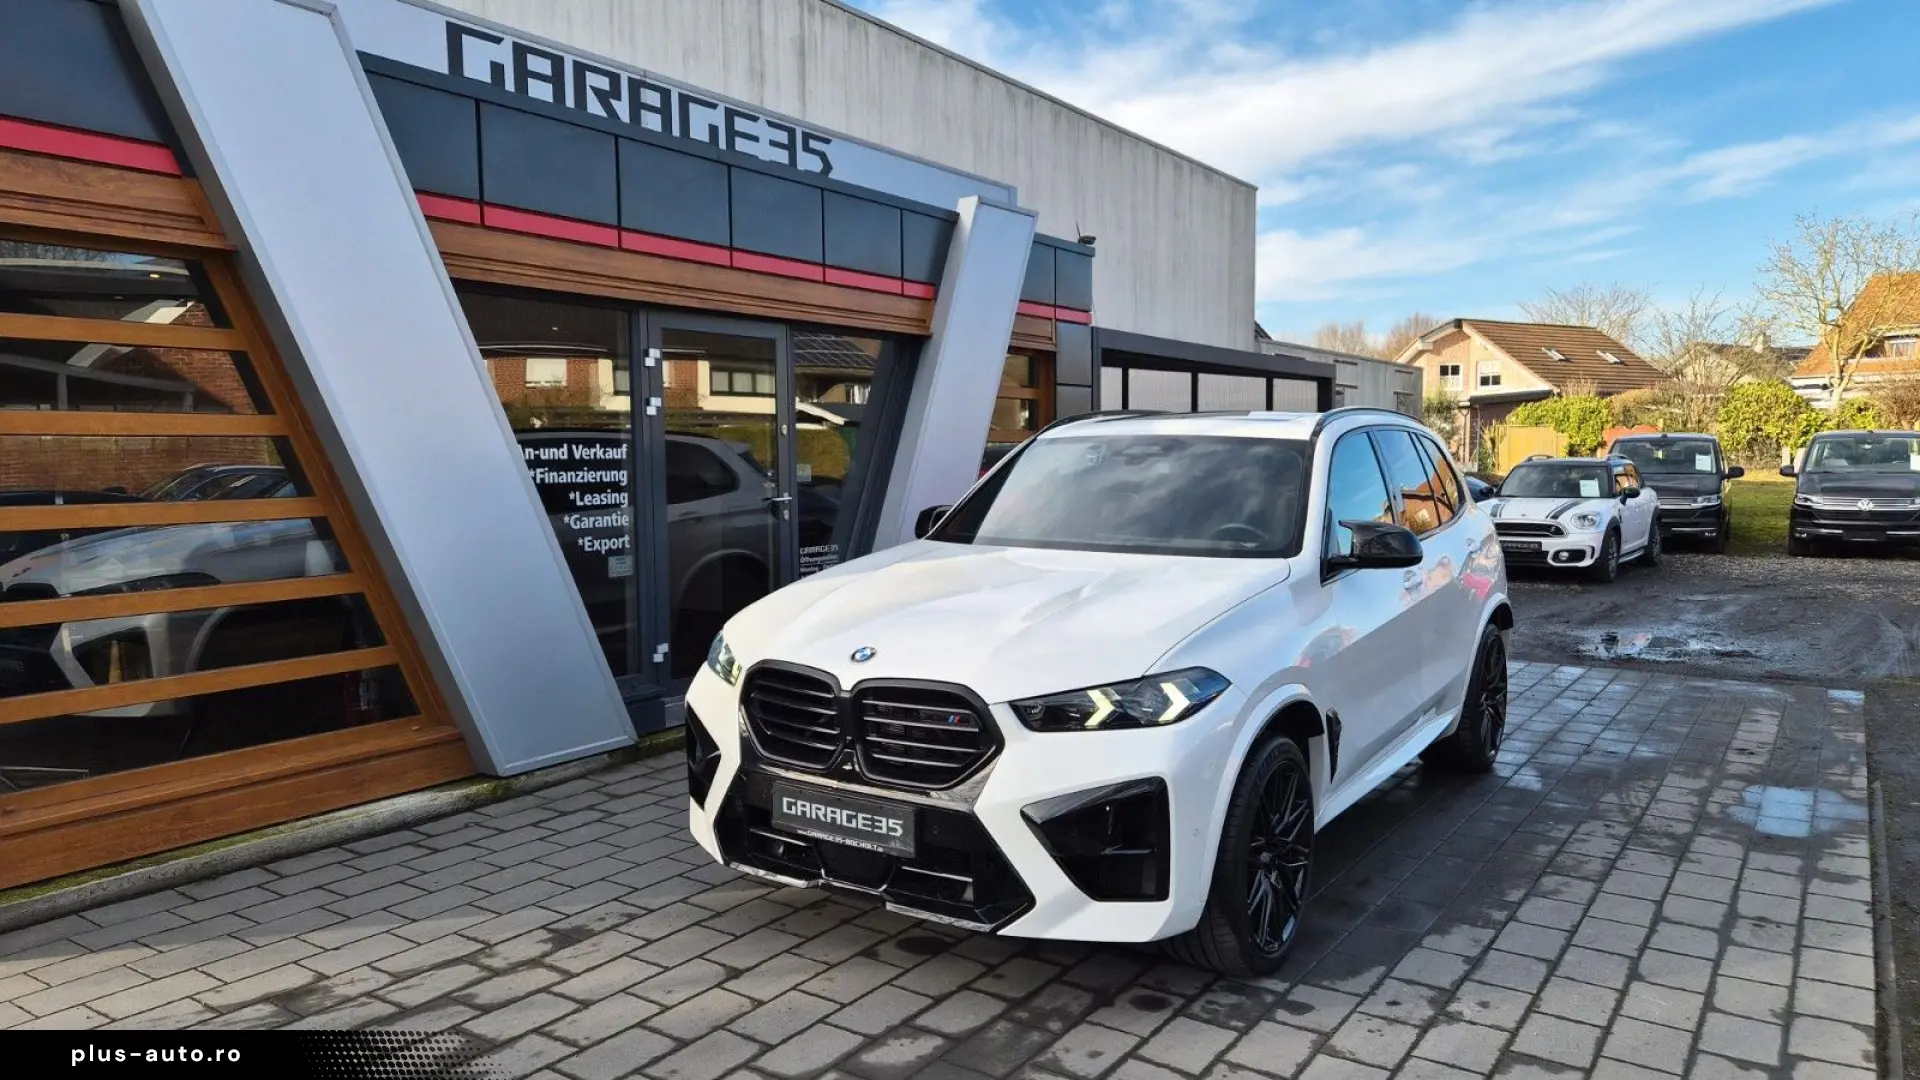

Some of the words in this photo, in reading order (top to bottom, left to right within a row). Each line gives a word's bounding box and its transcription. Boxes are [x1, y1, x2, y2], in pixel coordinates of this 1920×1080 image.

[445, 20, 834, 178] GARAGE35
[519, 443, 569, 460] n-und
[572, 443, 628, 461] Verkauf
[781, 796, 904, 837] GARAGE35
